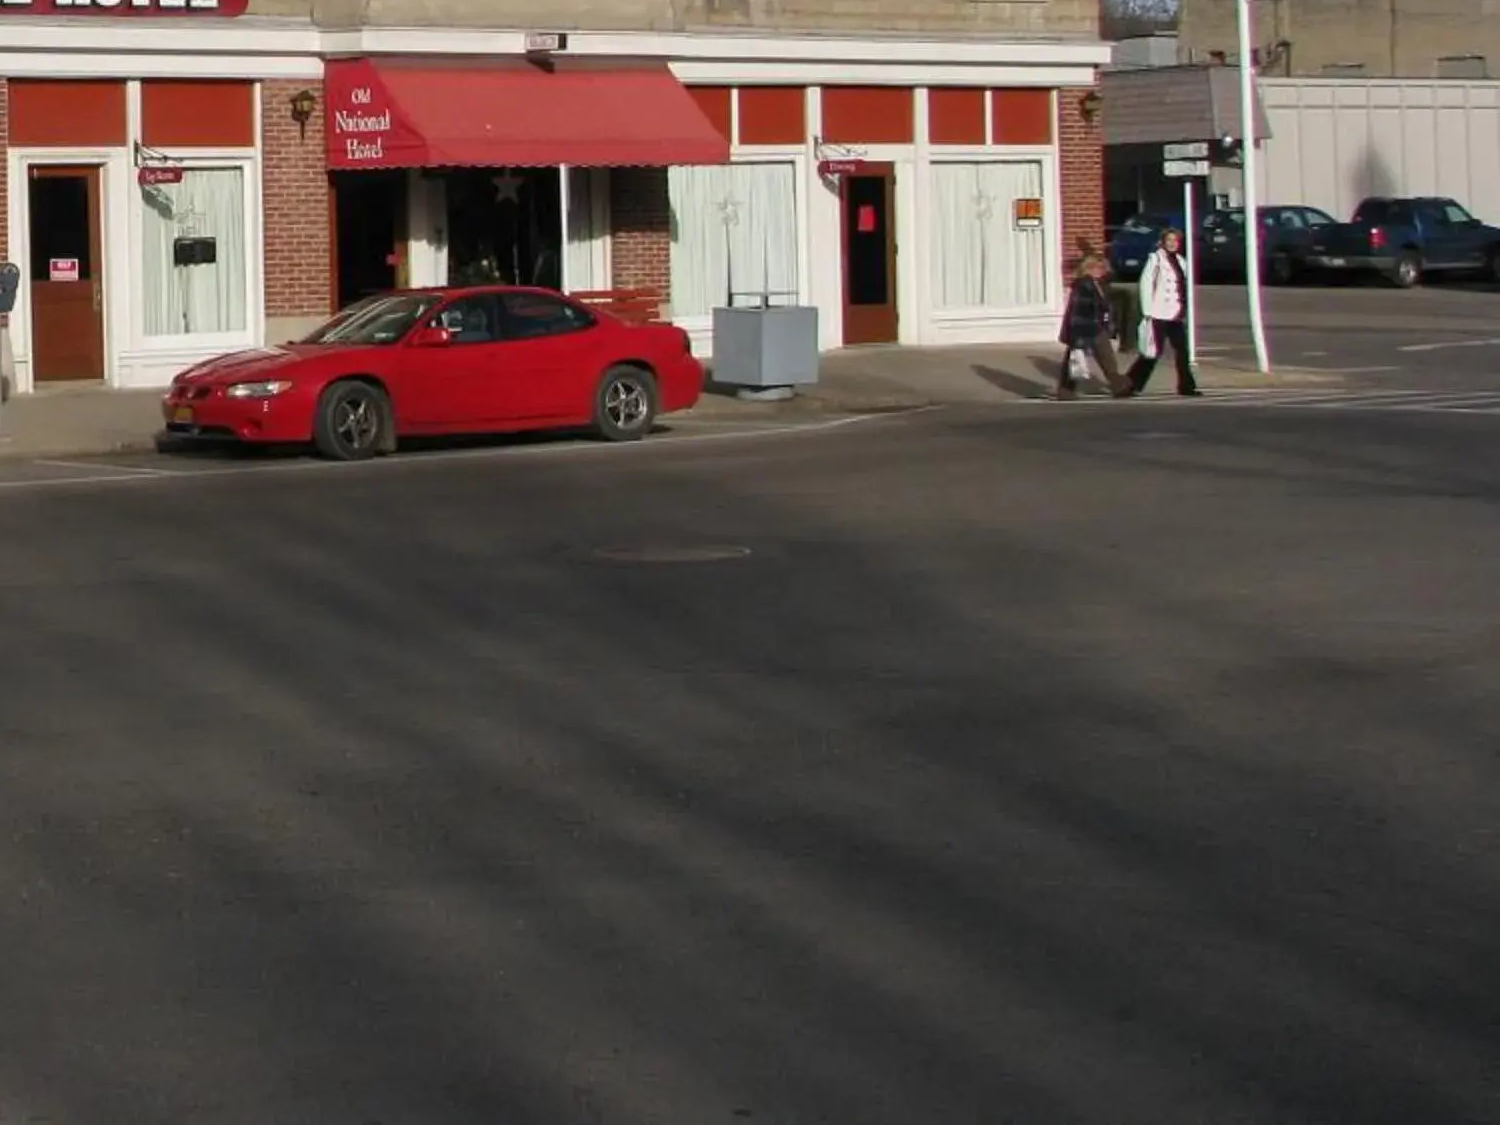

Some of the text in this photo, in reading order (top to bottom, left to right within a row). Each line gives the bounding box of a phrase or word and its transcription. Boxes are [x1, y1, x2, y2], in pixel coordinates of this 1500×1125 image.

[351, 87, 371, 104] Old
[334, 107, 391, 134] National
[346, 136, 384, 160] Hotel
